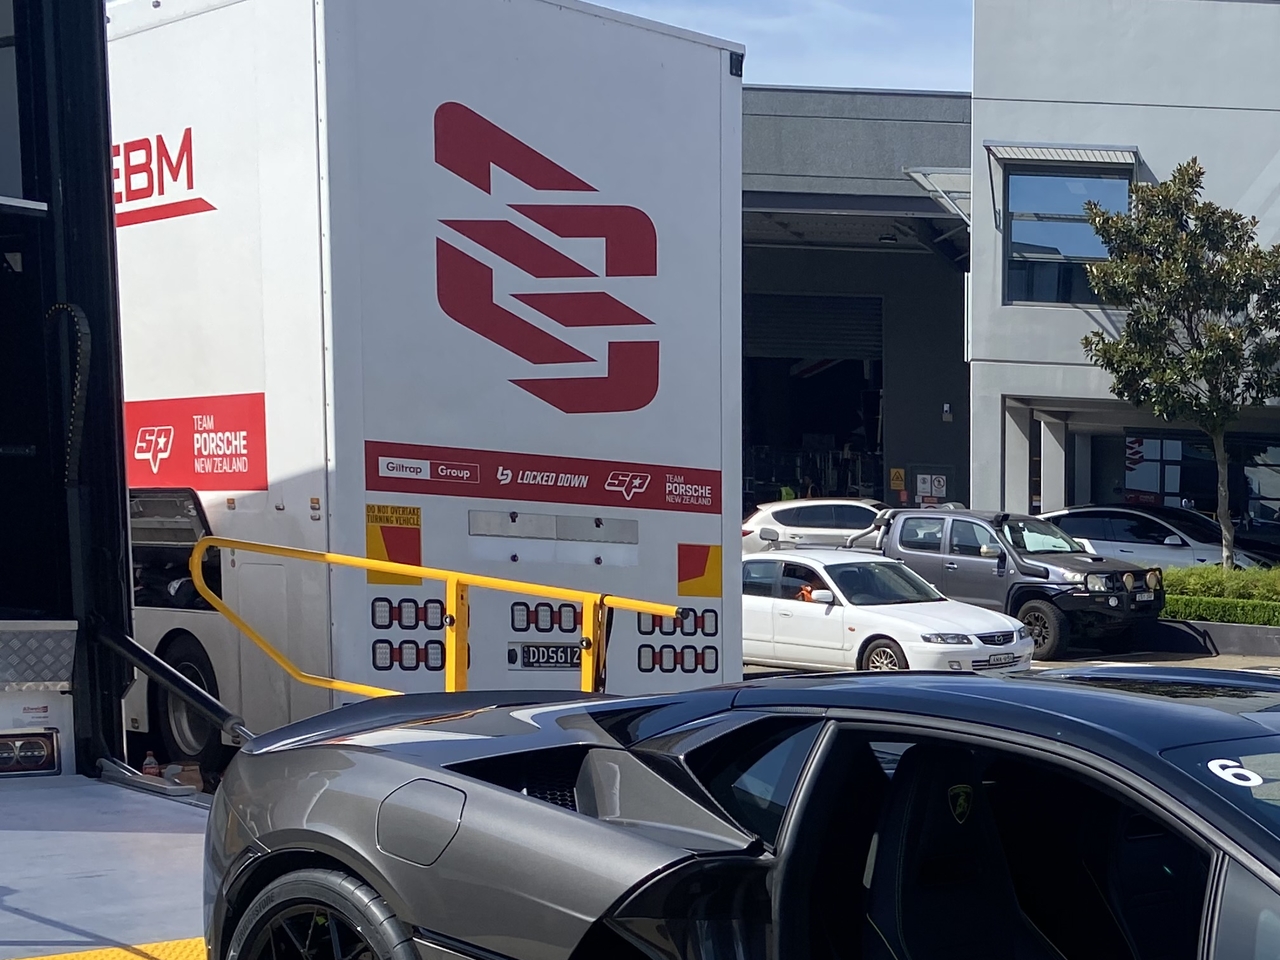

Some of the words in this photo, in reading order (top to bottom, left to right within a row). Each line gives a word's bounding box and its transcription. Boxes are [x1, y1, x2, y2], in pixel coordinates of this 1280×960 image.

[192, 415, 214, 431] TEAM
[193, 431, 248, 456] PORSCHE
[194, 458, 212, 473] NEW
[213, 457, 248, 473] ZEALAND
[386, 461, 422, 475] Giltrap
[438, 465, 470, 480] Group
[517, 470, 556, 486] LOCKED
[557, 473, 589, 488] DOWN
[665, 474, 684, 483] TEAM
[665, 483, 711, 497] PORSCHE
[666, 495, 681, 504] NEW
[682, 496, 711, 506] ZEALAND
[377, 506, 389, 515] NOT
[390, 506, 420, 517] OVERTAKE
[367, 514, 394, 525] TURNING
[395, 516, 420, 527] VEHICLE
[1207, 758, 1264, 787] 6
